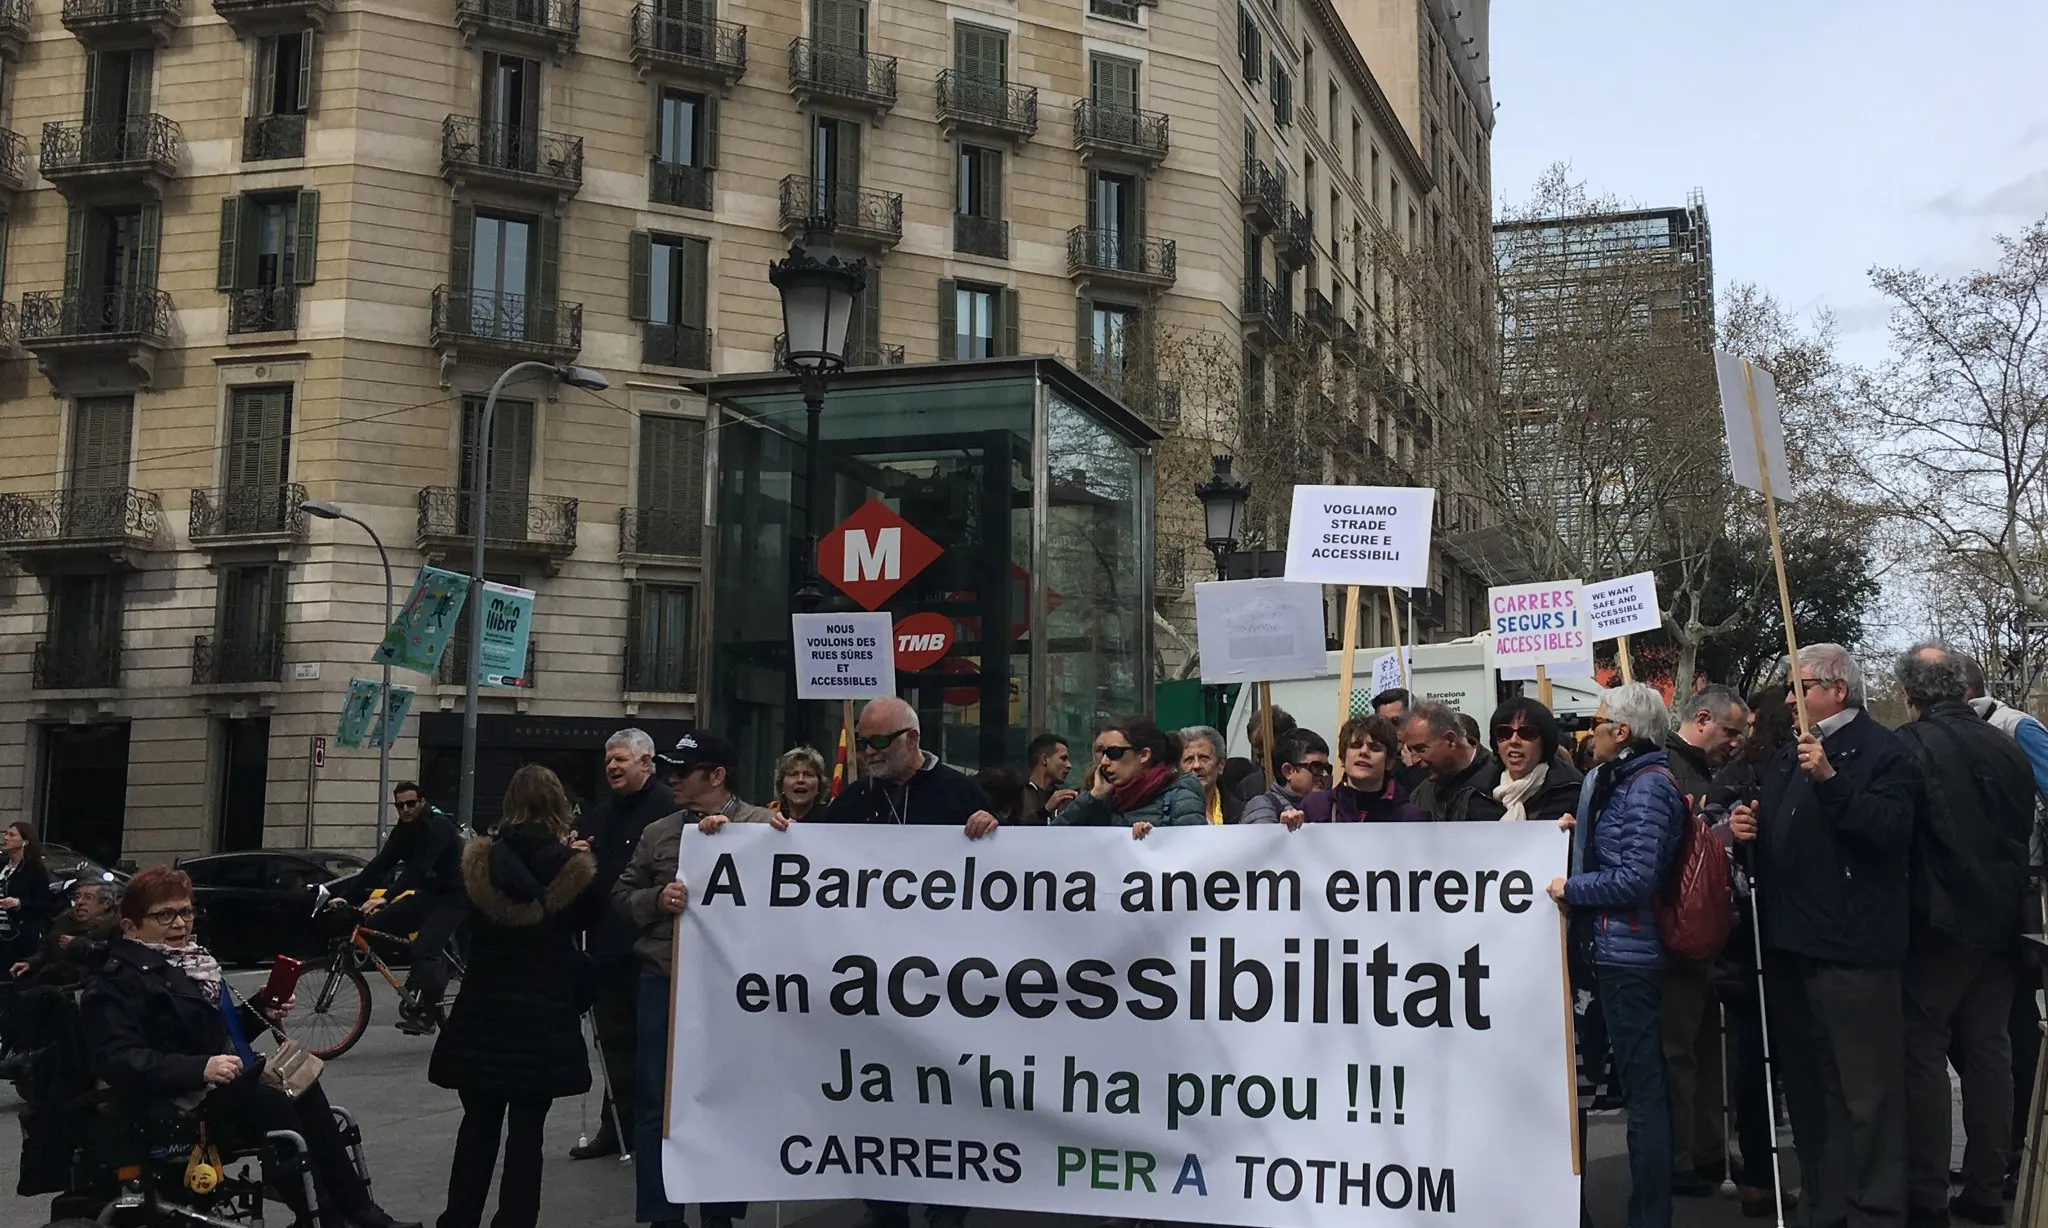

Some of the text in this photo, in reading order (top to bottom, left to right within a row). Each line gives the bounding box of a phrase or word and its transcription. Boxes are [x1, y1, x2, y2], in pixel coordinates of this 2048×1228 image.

[1323, 504, 1398, 516] VOGLIAMO
[1331, 519, 1387, 531] STRADE
[1322, 534, 1392, 546] SECURE E
[844, 528, 901, 582] M
[1312, 548, 1400, 561] ACCESSIBILI
[1592, 585, 1634, 601] WE WANT
[1494, 590, 1574, 613] CARRERS
[1593, 594, 1637, 610] SAFE AND
[1497, 611, 1565, 634] SEGURS
[1597, 613, 1639, 629] STREETS
[826, 625, 855, 634] NOUS
[807, 638, 877, 648] VOULONS DES
[897, 634, 946, 652] TMB
[1496, 631, 1584, 655] ACCESSIBLES
[811, 648, 874, 660] RUES SÛRES
[837, 664, 850, 673] ET
[810, 676, 878, 687] ACCESSIBLES
[1426, 691, 1466, 699] Barcelona
[700, 852, 1534, 915] A Barcelona anem enrere
[736, 936, 1492, 1031] en accessibilitat
[821, 1048, 895, 1103] Ja
[1062, 1055, 1141, 1115] ha
[1167, 1072, 1318, 1131] prou
[1347, 1063, 1405, 1126] !!!
[779, 1134, 1456, 1214] CARRERS PER A TOTHOM
